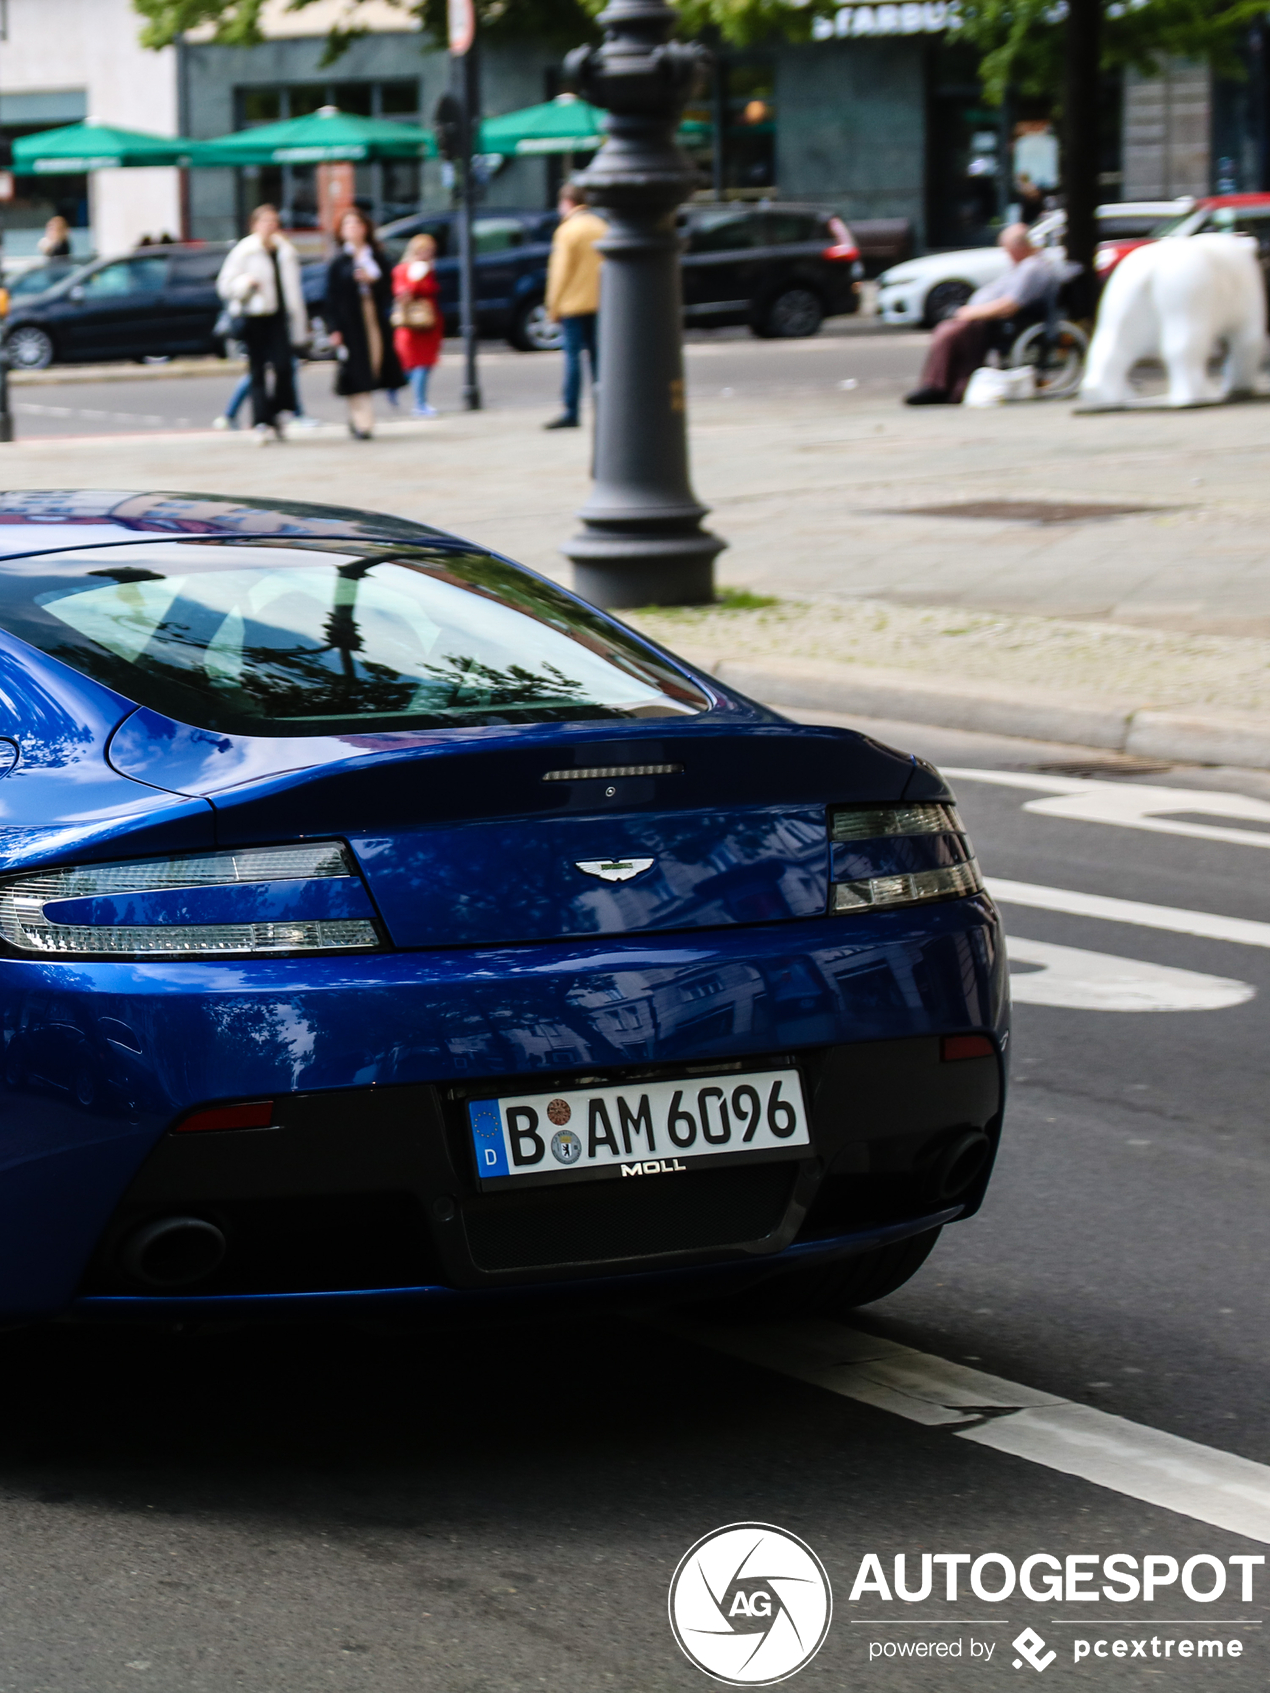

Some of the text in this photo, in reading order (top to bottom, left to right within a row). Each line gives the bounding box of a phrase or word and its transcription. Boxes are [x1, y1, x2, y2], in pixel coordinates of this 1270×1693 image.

[506, 1106, 545, 1166] B
[588, 1094, 656, 1158] AM
[667, 1080, 797, 1148] 6096
[485, 1149, 497, 1166] D
[620, 1158, 687, 1177] MOLL
